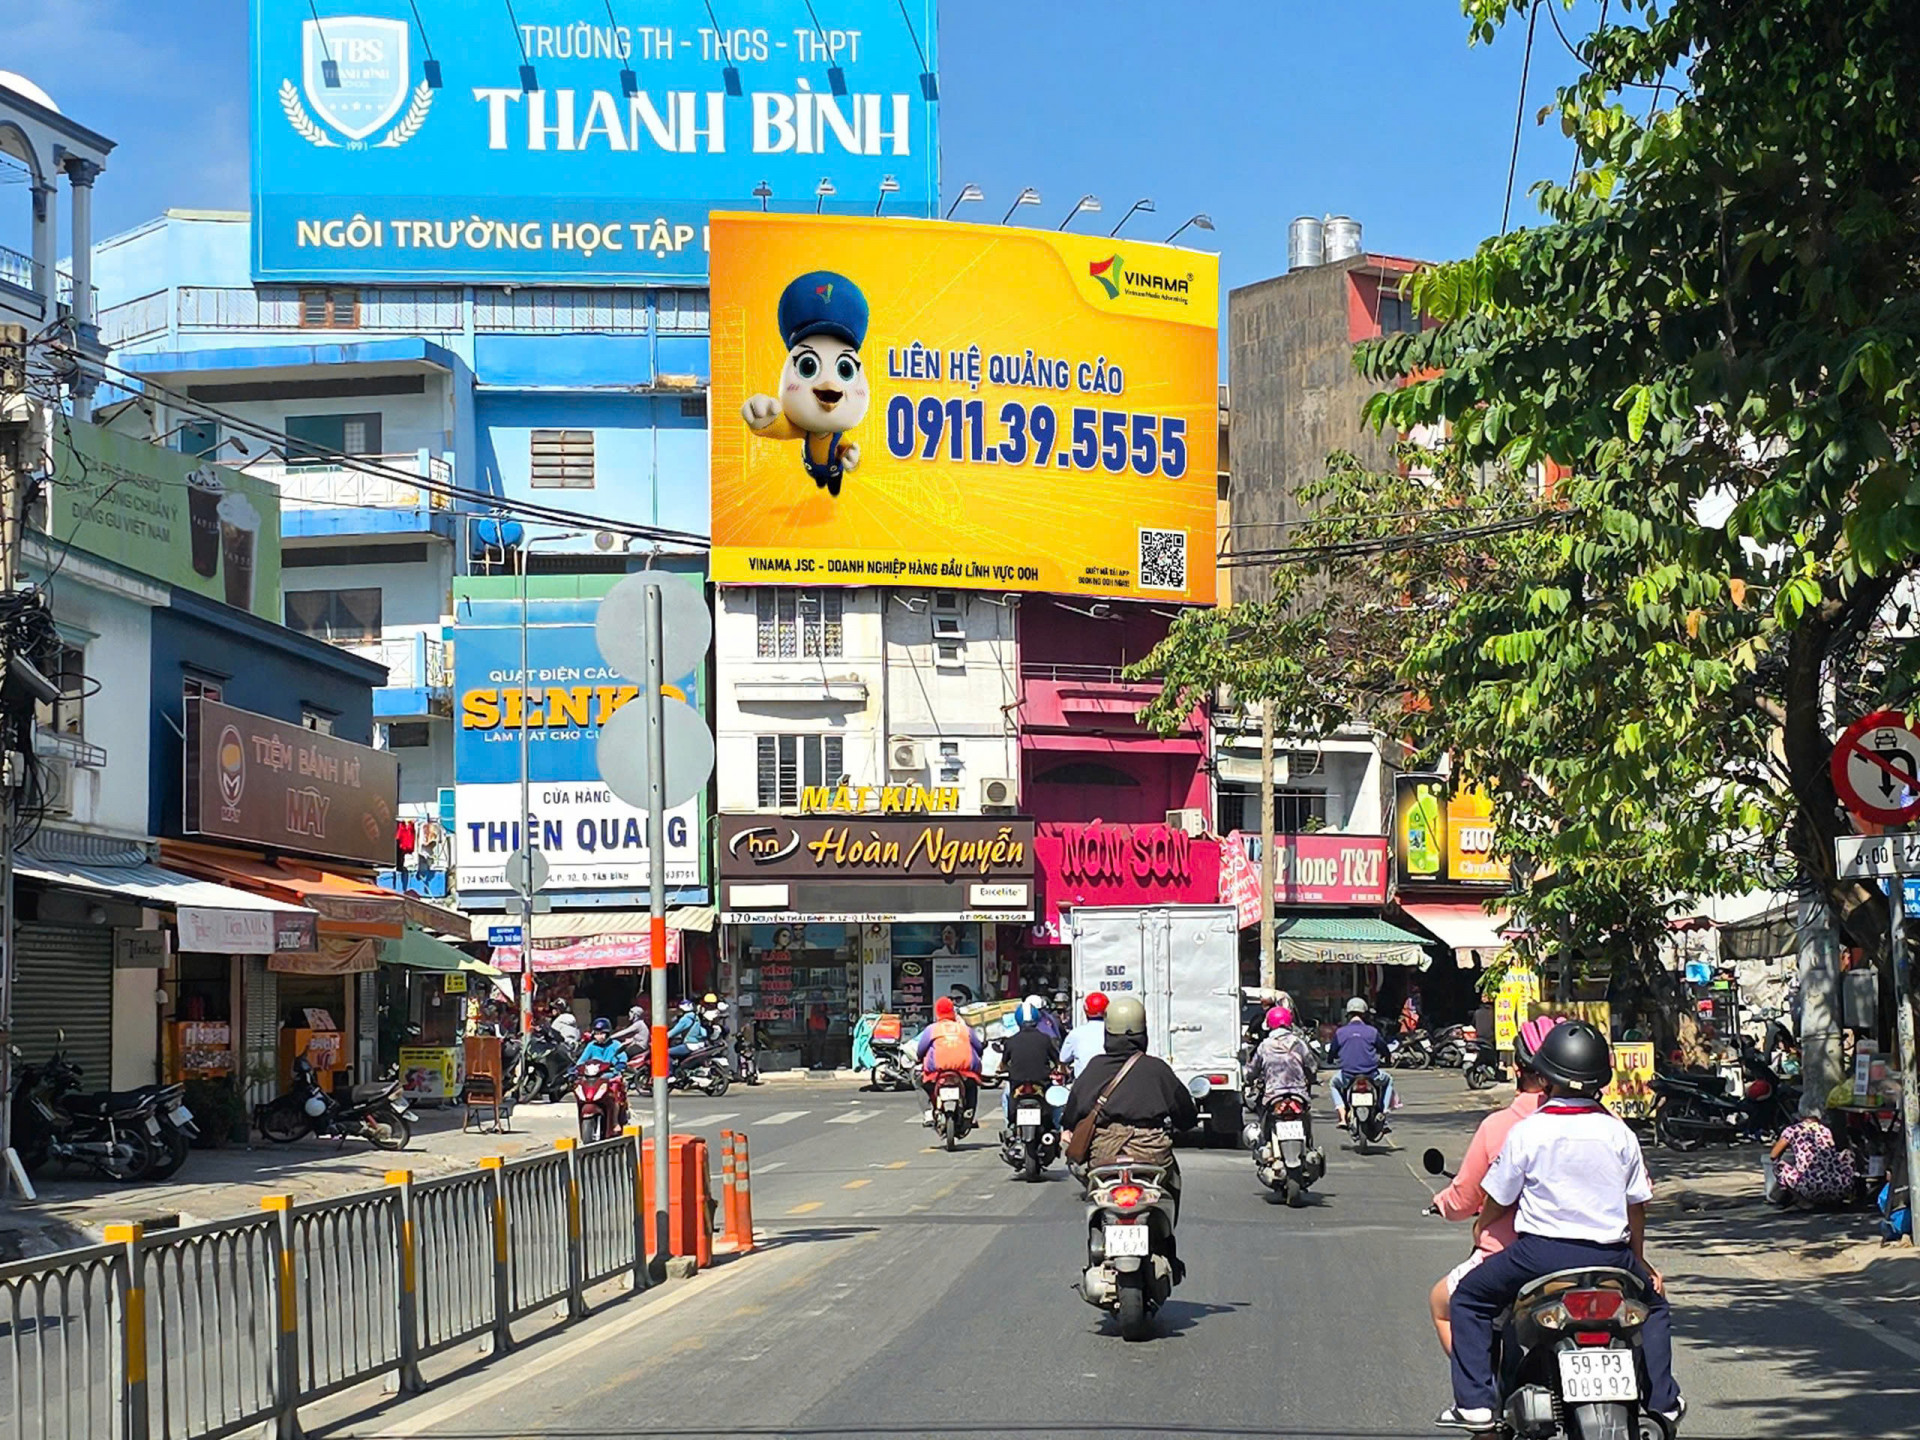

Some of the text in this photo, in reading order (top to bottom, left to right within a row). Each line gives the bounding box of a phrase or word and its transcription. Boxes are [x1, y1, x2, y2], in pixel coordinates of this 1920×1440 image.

[329, 38, 384, 63] TBS
[520, 20, 631, 59] TRƯỜNG
[638, 27, 673, 60] TH
[698, 28, 769, 62] THCS
[793, 29, 862, 63] THPT
[472, 78, 911, 156] THANH BÌNH
[297, 214, 383, 249] NGÔI
[391, 215, 542, 251] TRƯỜNG
[551, 222, 623, 258] HỌC
[630, 219, 695, 259] TẬP
[1124, 271, 1189, 294] VINAMA
[888, 341, 1123, 395] LIÊN HỆ QUẢNG CÁO
[887, 395, 1187, 478] 0911.39.5555
[749, 557, 791, 572] VINAMA
[794, 558, 815, 572] JSC
[827, 559, 864, 574] DOANH
[867, 557, 906, 580] NGHIỆP
[908, 557, 938, 576] HÀNG
[1017, 567, 1039, 582] OOH
[539, 666, 581, 684] ĐIỆN
[252, 733, 294, 773] TIỆM
[299, 745, 339, 783] BÁNH
[574, 789, 611, 804] HÀNG
[749, 833, 779, 855] hn
[808, 826, 1023, 874] Hoàn Nguyễn
[1855, 847, 1888, 865] 6:00
[1341, 848, 1383, 887] T&T
[730, 913, 751, 923] 170
[1105, 965, 1126, 976] 51C
